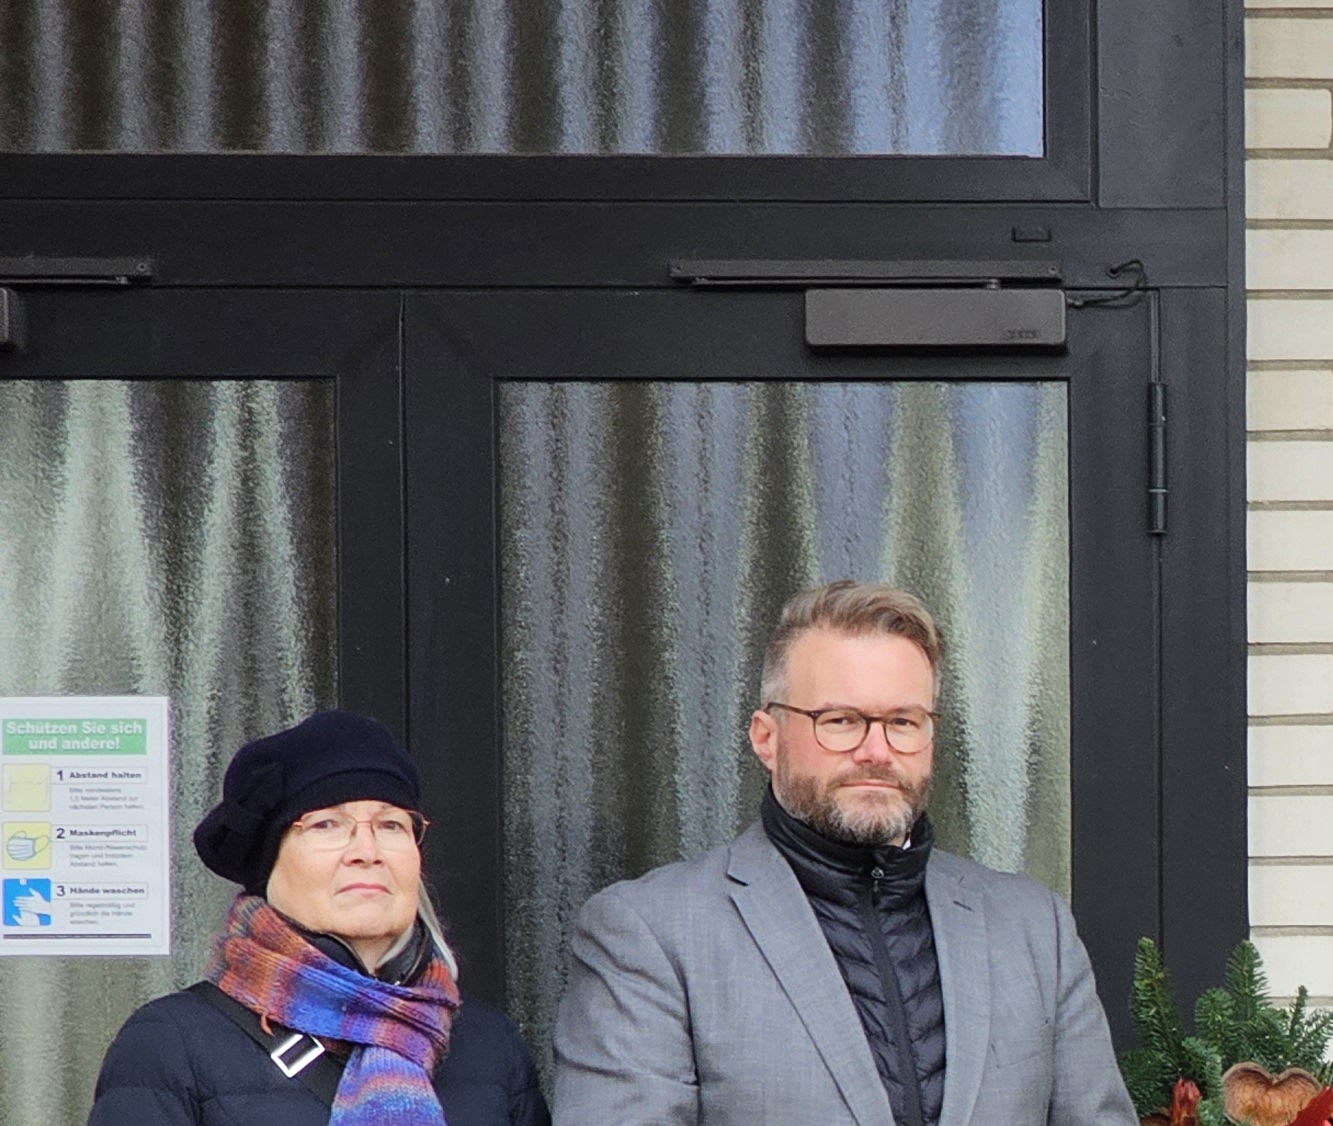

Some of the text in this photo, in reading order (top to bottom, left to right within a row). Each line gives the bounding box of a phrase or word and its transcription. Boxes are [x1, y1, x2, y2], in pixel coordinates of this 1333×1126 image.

[6, 721, 143, 735] Schützen Sie sich
[28, 737, 121, 750] und andere!
[57, 770, 64, 781] 1
[56, 827, 66, 839] 2
[56, 885, 66, 897] 3
